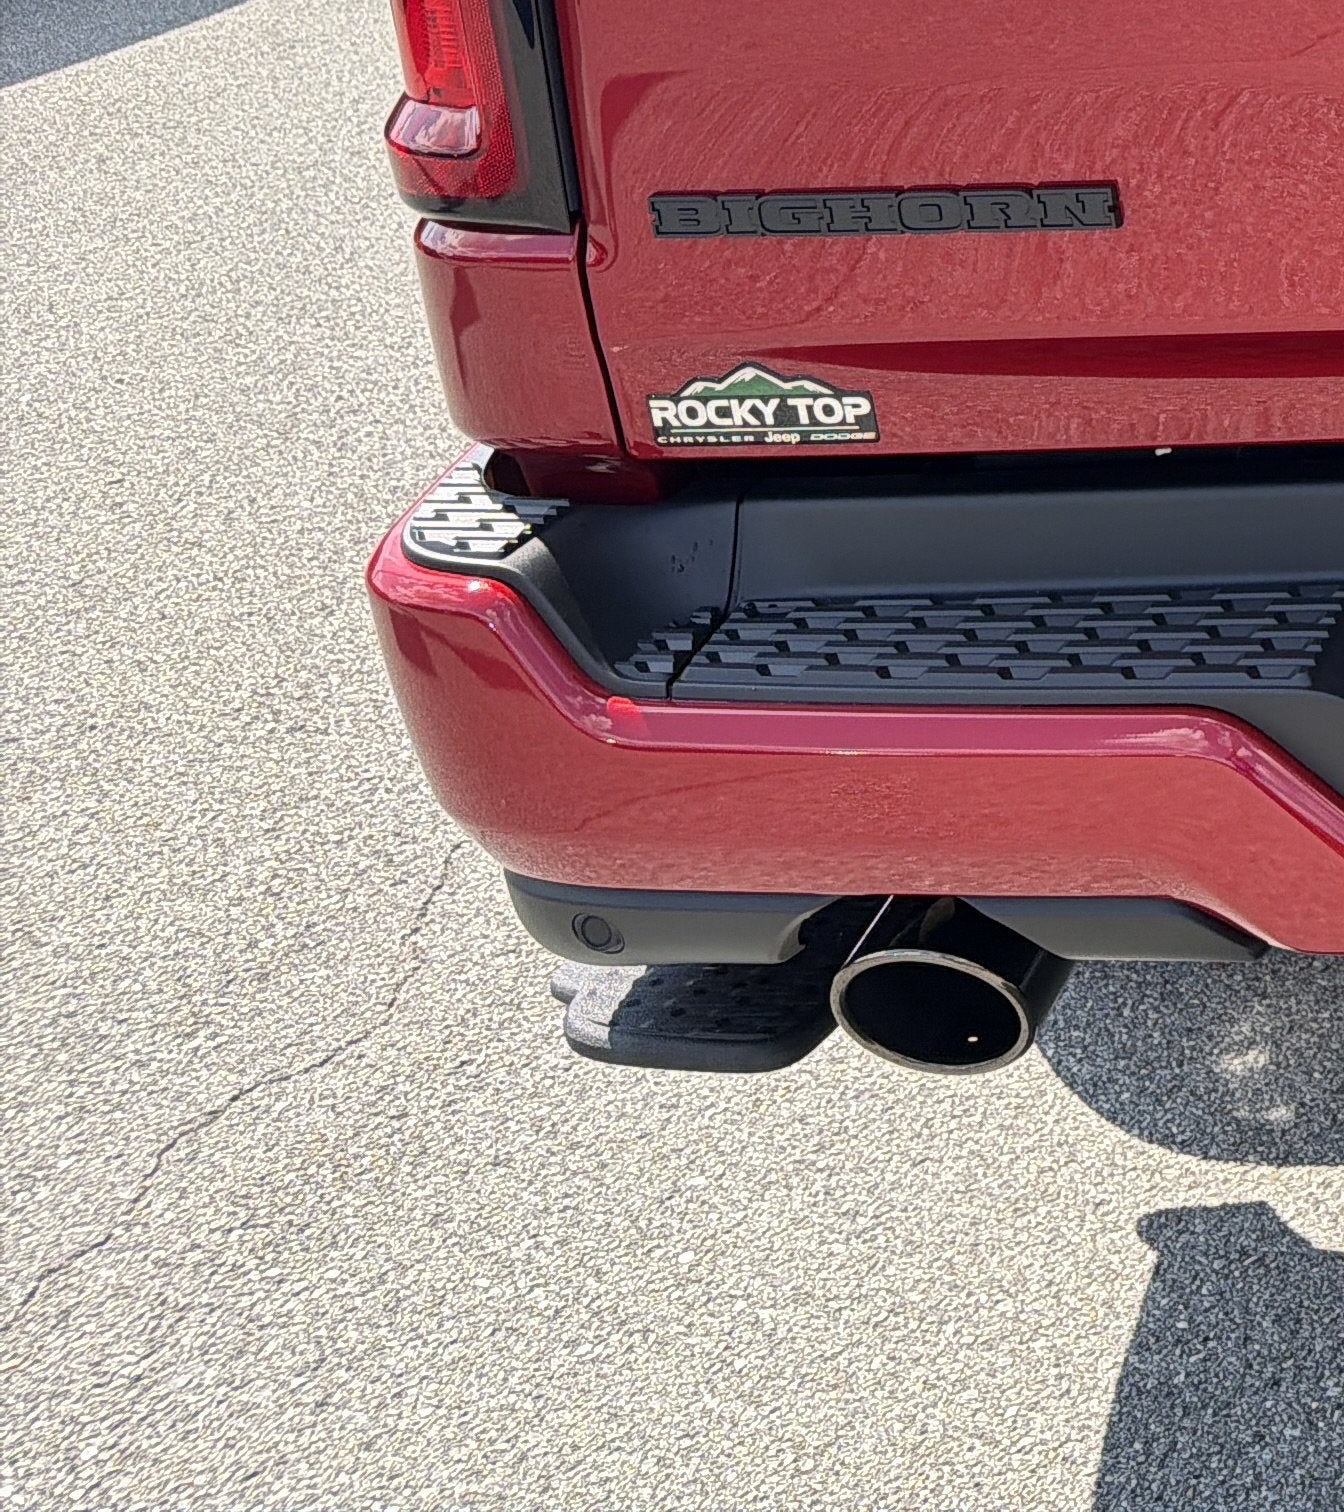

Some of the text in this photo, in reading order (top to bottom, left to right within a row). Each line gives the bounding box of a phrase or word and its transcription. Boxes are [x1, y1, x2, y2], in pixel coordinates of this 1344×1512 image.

[649, 182, 1123, 237] BIGHORN
[649, 396, 872, 428] ROCKY TOP
[657, 430, 877, 445] CHRYSLER Jeep DODGE
